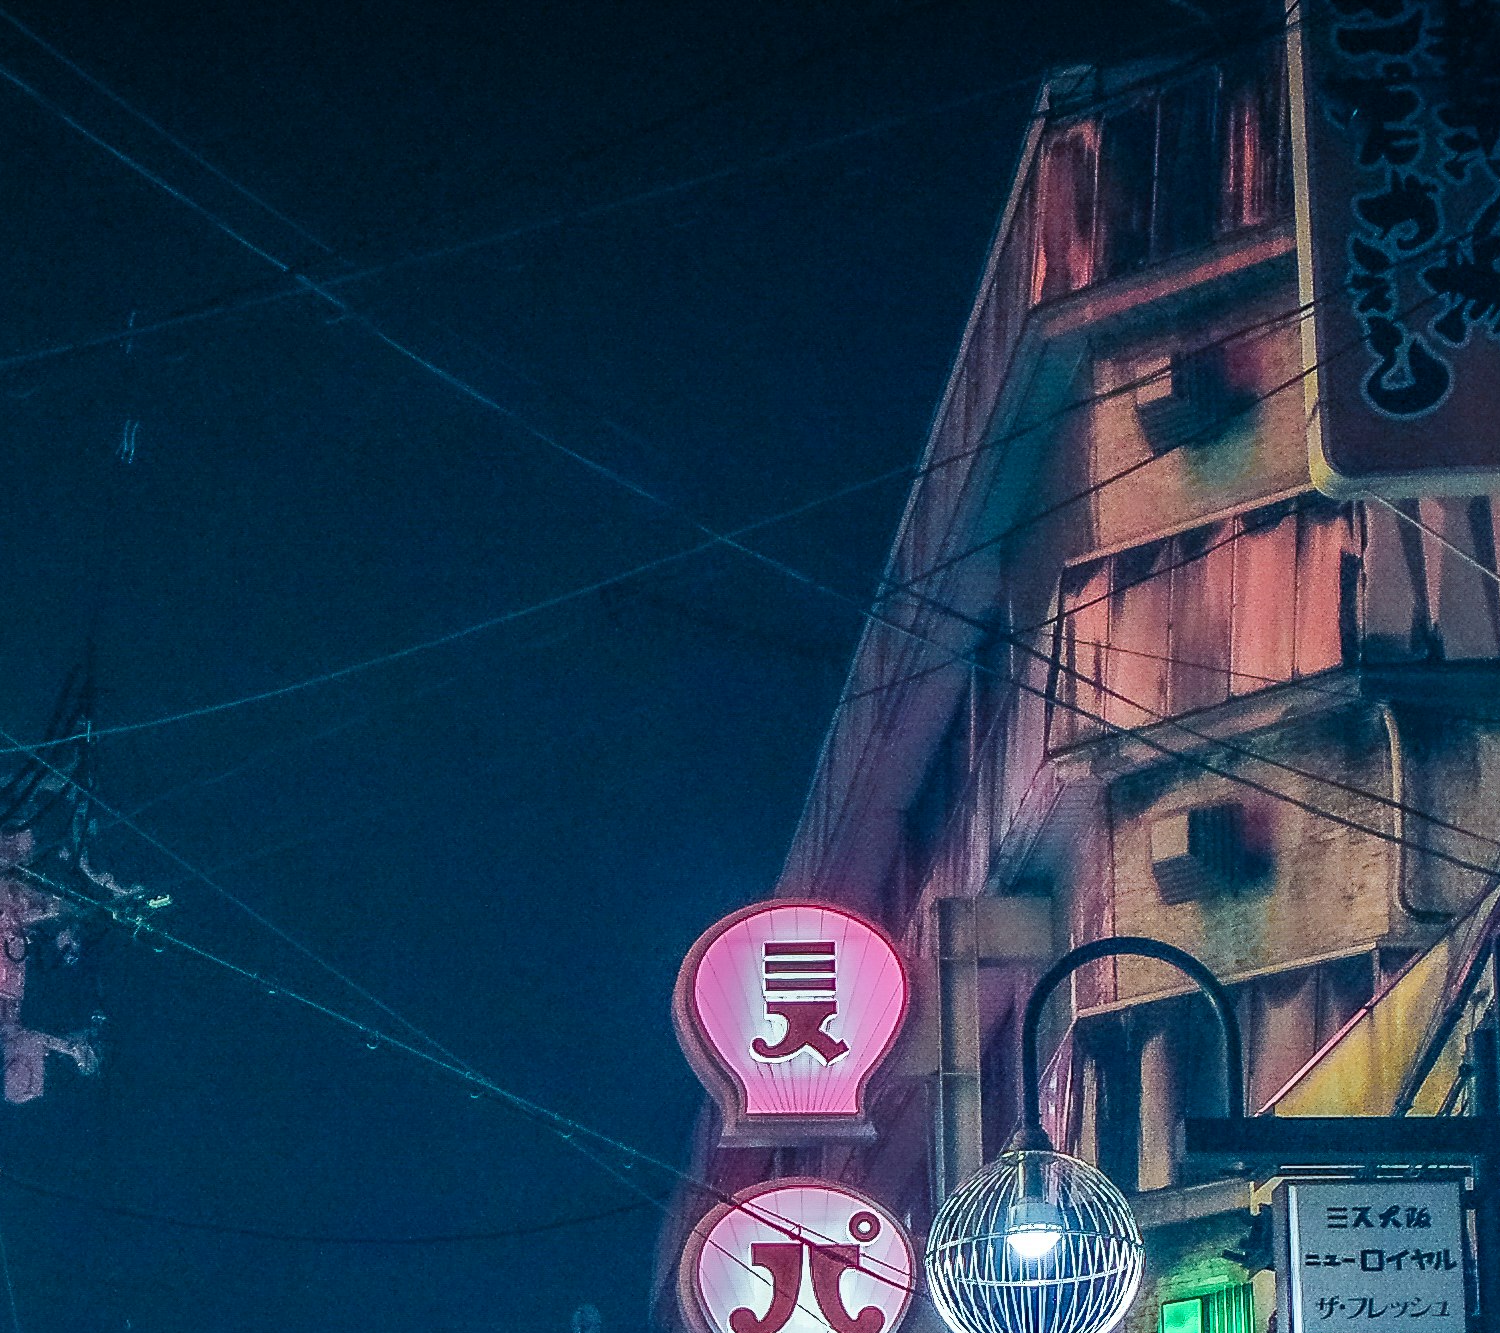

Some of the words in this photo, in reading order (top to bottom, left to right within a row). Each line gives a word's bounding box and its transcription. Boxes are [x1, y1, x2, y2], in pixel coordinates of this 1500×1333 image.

[1305, 1249, 1457, 1271] ニューロイヤル
